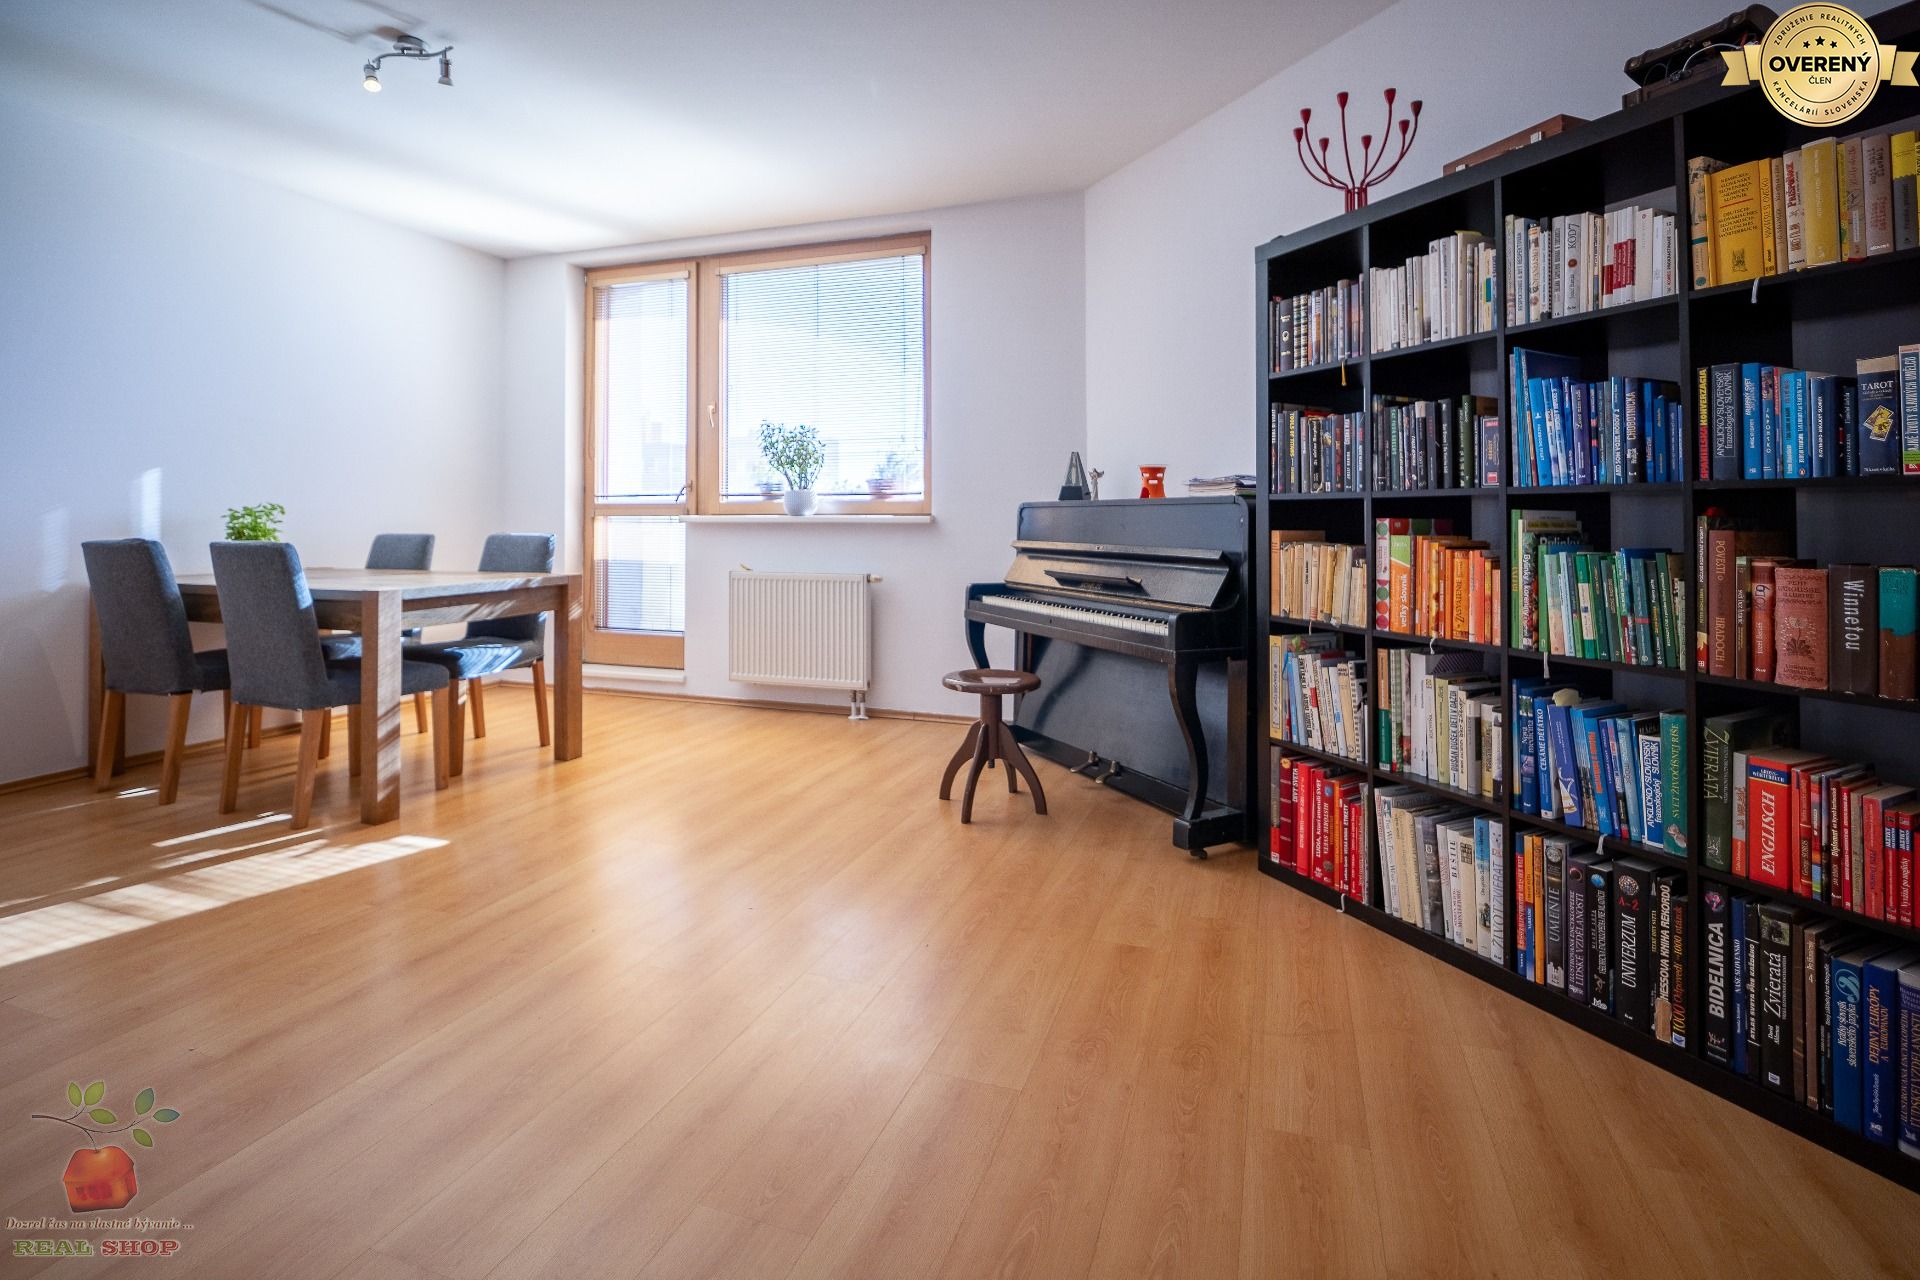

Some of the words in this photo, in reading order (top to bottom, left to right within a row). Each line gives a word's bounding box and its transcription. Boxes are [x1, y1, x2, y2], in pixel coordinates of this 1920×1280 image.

[1861, 381, 1893, 390] TAROT
[1843, 580, 1865, 651] Winnetou
[1761, 789, 1775, 876] ENGLISCH
[1548, 888, 1560, 942] UMENIE
[1622, 913, 1636, 988] UNIVERZUM
[1708, 922, 1725, 1019] BIDELNICA
[1763, 950, 1781, 1019] Zvieratá
